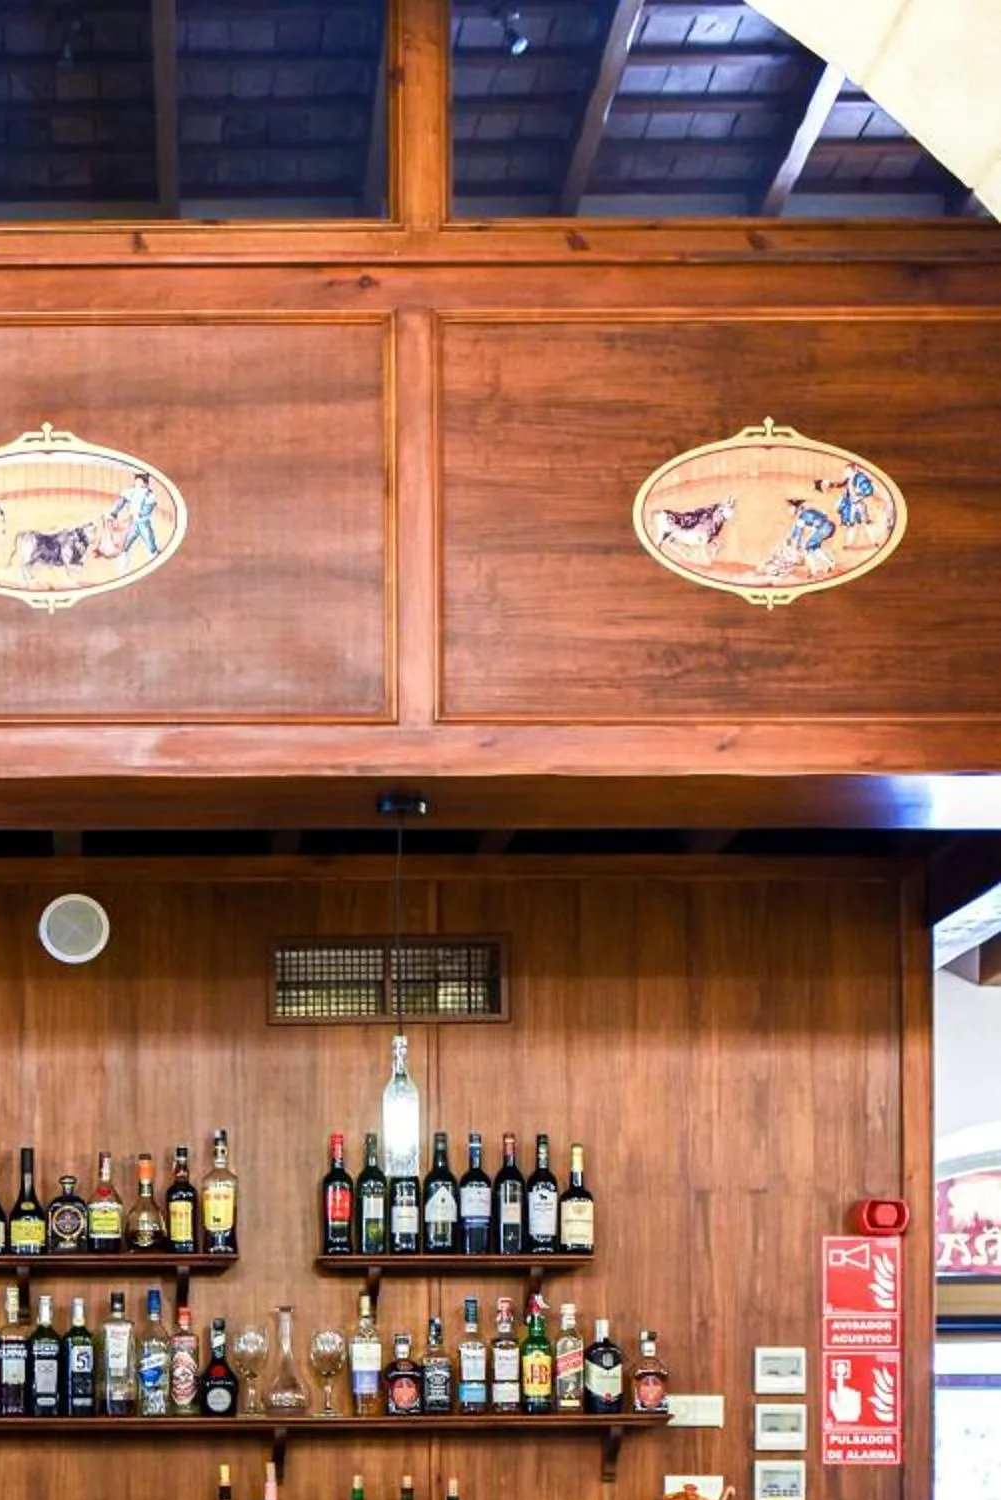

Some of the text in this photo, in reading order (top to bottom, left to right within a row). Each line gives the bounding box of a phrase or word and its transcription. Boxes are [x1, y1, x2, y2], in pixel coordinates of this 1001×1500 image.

[831, 1321, 891, 1331] AVISADOR
[831, 1334, 891, 1344] ACUSTICO
[830, 1434, 893, 1445] PULSADOR
[828, 1449, 895, 1459] DE ALARMA
